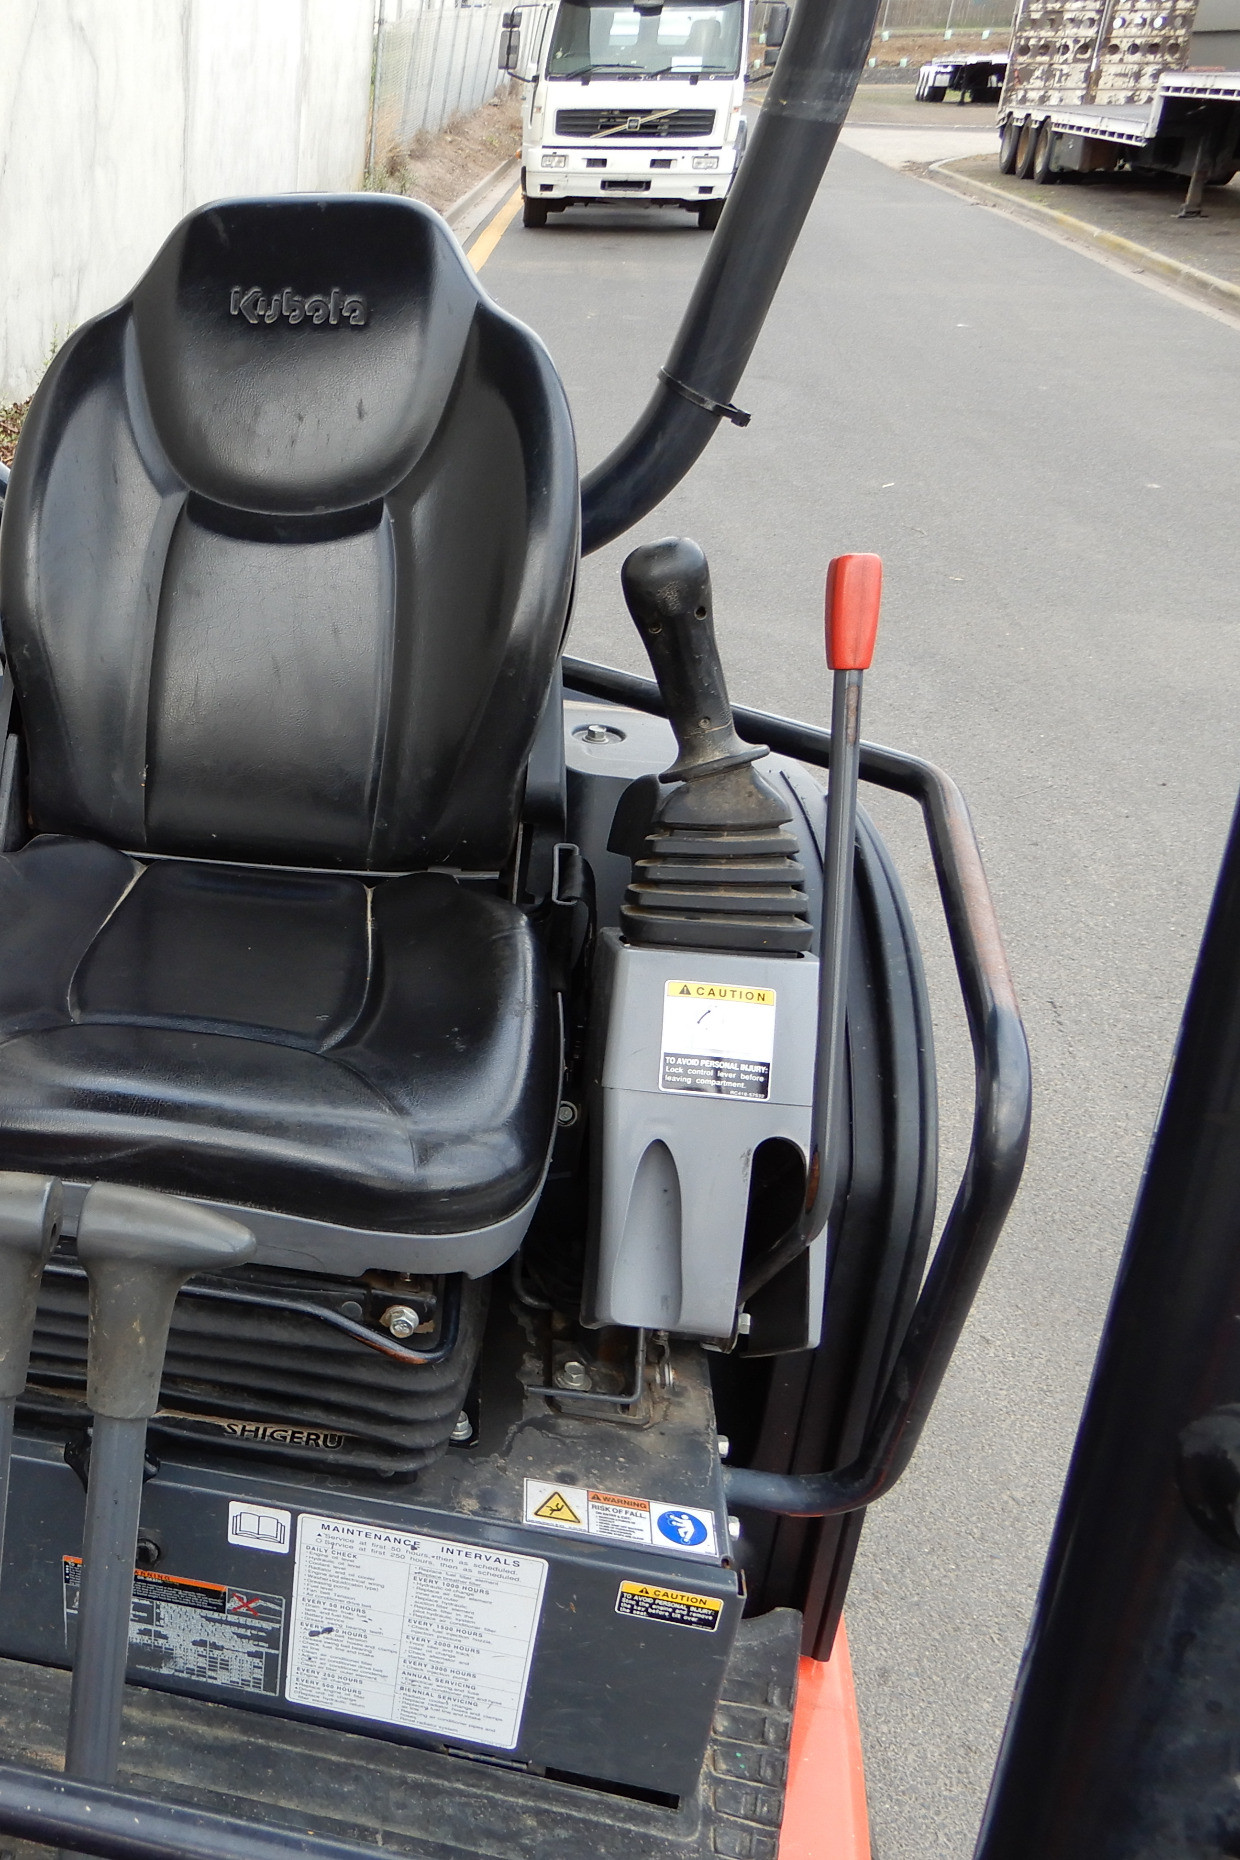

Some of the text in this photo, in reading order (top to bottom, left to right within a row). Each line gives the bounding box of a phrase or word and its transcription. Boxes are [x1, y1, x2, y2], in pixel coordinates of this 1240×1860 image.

[230, 288, 365, 324] Kubota
[696, 986, 765, 1001] CAUTION
[677, 1057, 699, 1066] AVOID
[700, 1060, 739, 1070] PERSONAL
[665, 1065, 764, 1082] Lock control lever before
[665, 1074, 691, 1084] leaving
[224, 1422, 345, 1450] SHIGERU
[591, 1504, 610, 1512] RISK
[602, 1495, 647, 1509] WARNING
[305, 1544, 358, 1559] DAILY CHECK
[321, 1523, 521, 1567] MAINTENANCE INTERVALS
[371, 1542, 386, 1550] first
[324, 1539, 354, 1550] Service
[371, 1548, 386, 1556] first
[390, 1552, 406, 1560] 250
[439, 1561, 458, 1570] then
[413, 1575, 439, 1585] EVERY
[442, 1581, 460, 1589] 1000
[462, 1585, 490, 1595] HOURS
[302, 1597, 326, 1606] EVERY
[339, 1604, 366, 1614] HOURS
[633, 1594, 654, 1603] AVOID
[654, 1599, 688, 1610] PERSONAL
[653, 1589, 707, 1605] CAUTION
[621, 1597, 637, 1605] Stop
[651, 1604, 673, 1612] engine
[689, 1611, 713, 1620] remove
[647, 1607, 670, 1616] before
[300, 1621, 324, 1630] EVERY
[341, 1629, 368, 1639] HOURS
[408, 1618, 433, 1627] EVERY
[456, 1628, 483, 1638] HOURS
[405, 1635, 431, 1644] EVERY
[453, 1644, 481, 1654] HOURS
[296, 1666, 321, 1675] EVERY
[337, 1675, 363, 1684] HOURS
[403, 1659, 428, 1668] EVERY
[450, 1669, 477, 1678] HOURS
[296, 1677, 320, 1686] EVERY
[336, 1685, 362, 1695] HOURS
[401, 1670, 432, 1681] ANNUAL
[434, 1677, 476, 1690] SERVICING
[399, 1686, 478, 1706] BIENNIAL SERVICING
